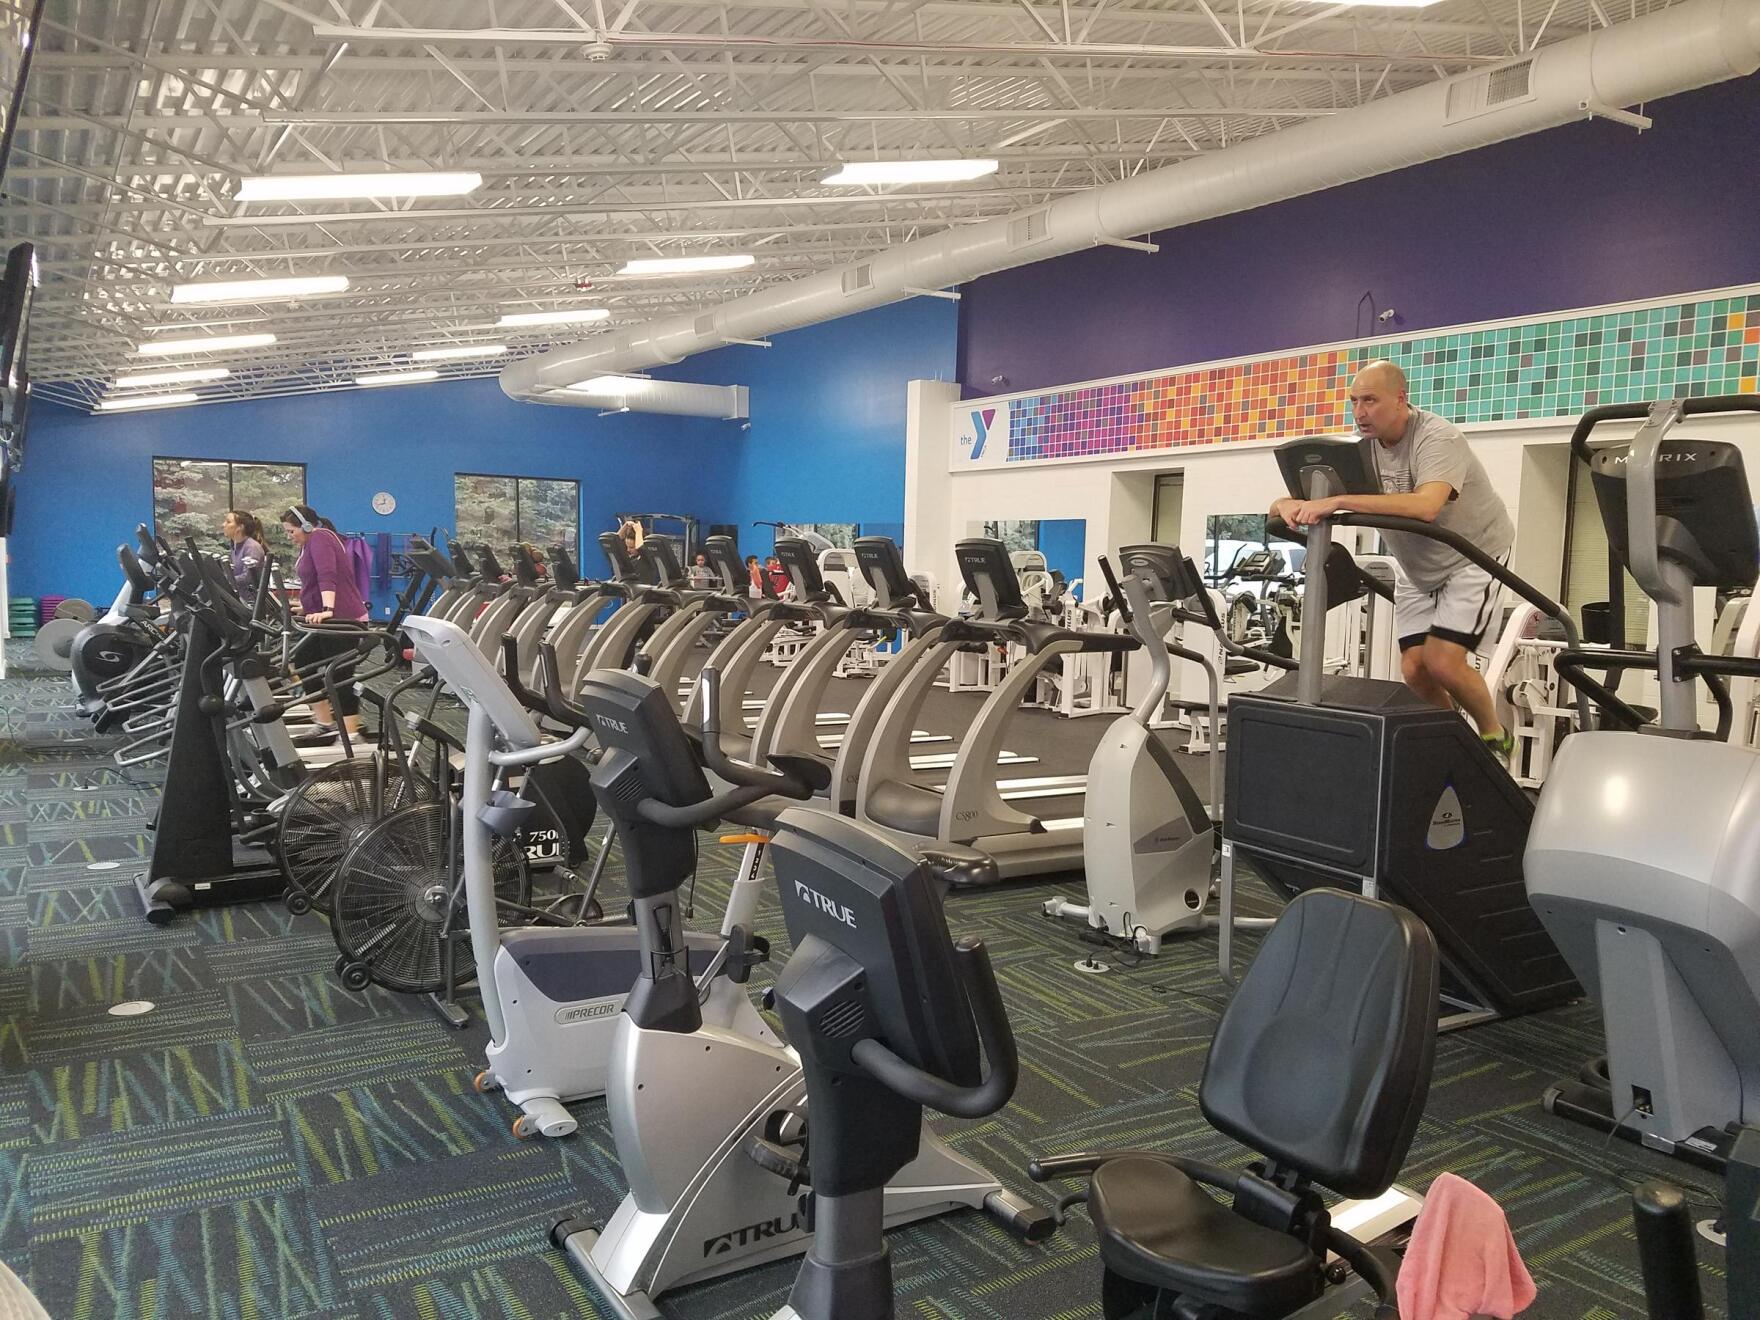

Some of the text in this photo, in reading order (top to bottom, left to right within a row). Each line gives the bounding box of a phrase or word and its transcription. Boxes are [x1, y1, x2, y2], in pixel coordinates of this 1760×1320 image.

[960, 409, 996, 460] the Y
[1614, 453, 1697, 464] MRIX
[604, 716, 629, 734] TRUE
[529, 829, 559, 842] 750
[524, 842, 560, 859] RU
[808, 888, 857, 929] TRUE
[572, 1004, 615, 1020] PRECOR
[733, 1212, 800, 1246] TRU
